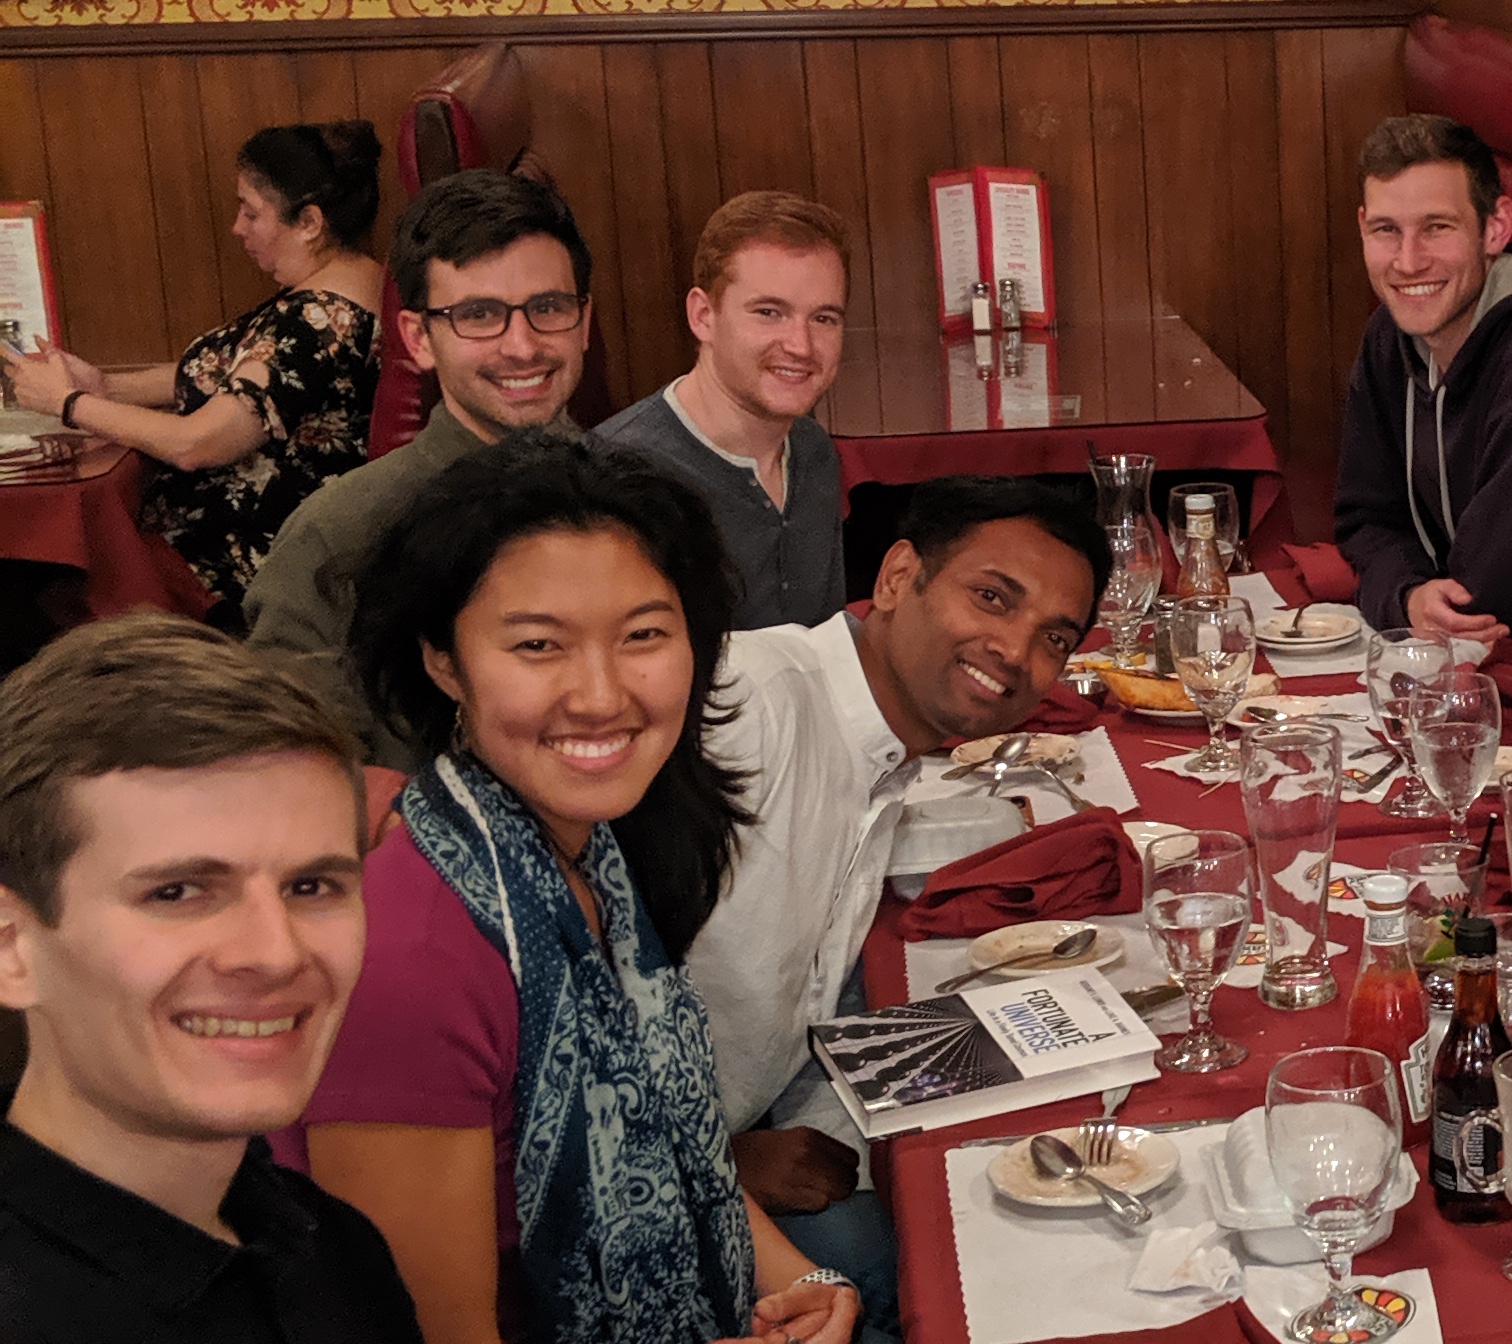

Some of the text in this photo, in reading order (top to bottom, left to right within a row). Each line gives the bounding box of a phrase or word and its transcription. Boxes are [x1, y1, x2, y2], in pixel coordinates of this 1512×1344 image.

[1000, 1002, 1061, 1055] UNIVERSE
[1021, 988, 1091, 1049] FORTUNATE
[1088, 1031, 1117, 1043] A
